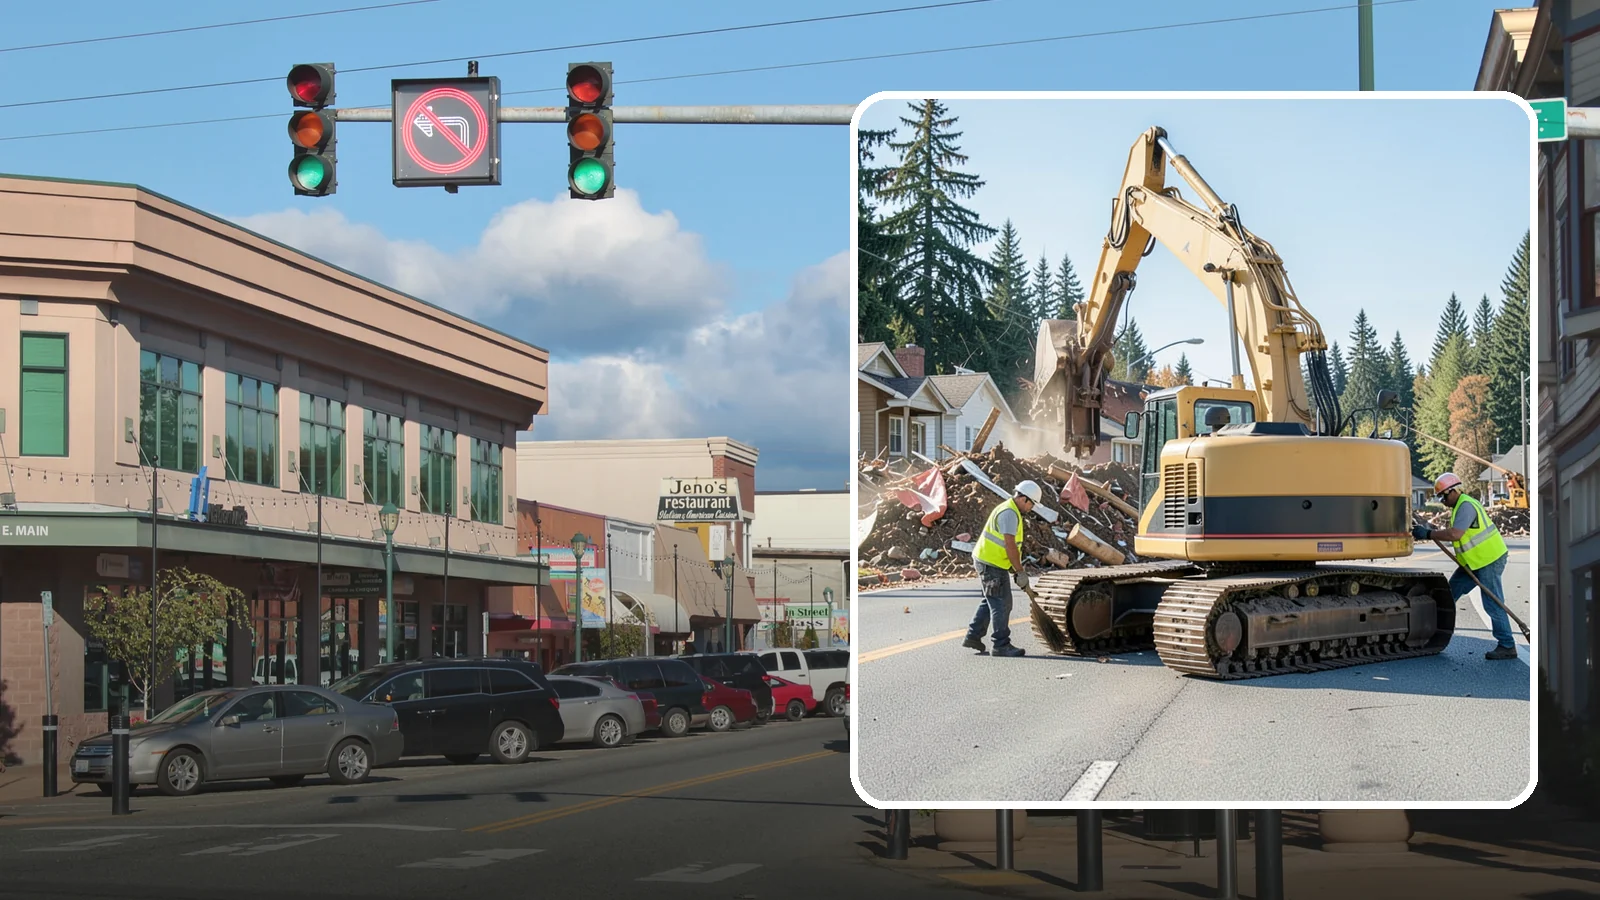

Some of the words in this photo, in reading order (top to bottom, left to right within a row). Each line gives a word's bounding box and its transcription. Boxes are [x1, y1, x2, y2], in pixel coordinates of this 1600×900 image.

[670, 480, 727, 494] Jeno's
[665, 496, 730, 508] restaurant
[658, 510, 680, 519] Italian
[686, 510, 714, 519] American
[715, 510, 737, 519] Cuisine
[2, 525, 12, 536] E.
[15, 525, 49, 536] MAIN
[798, 608, 828, 617] Street
